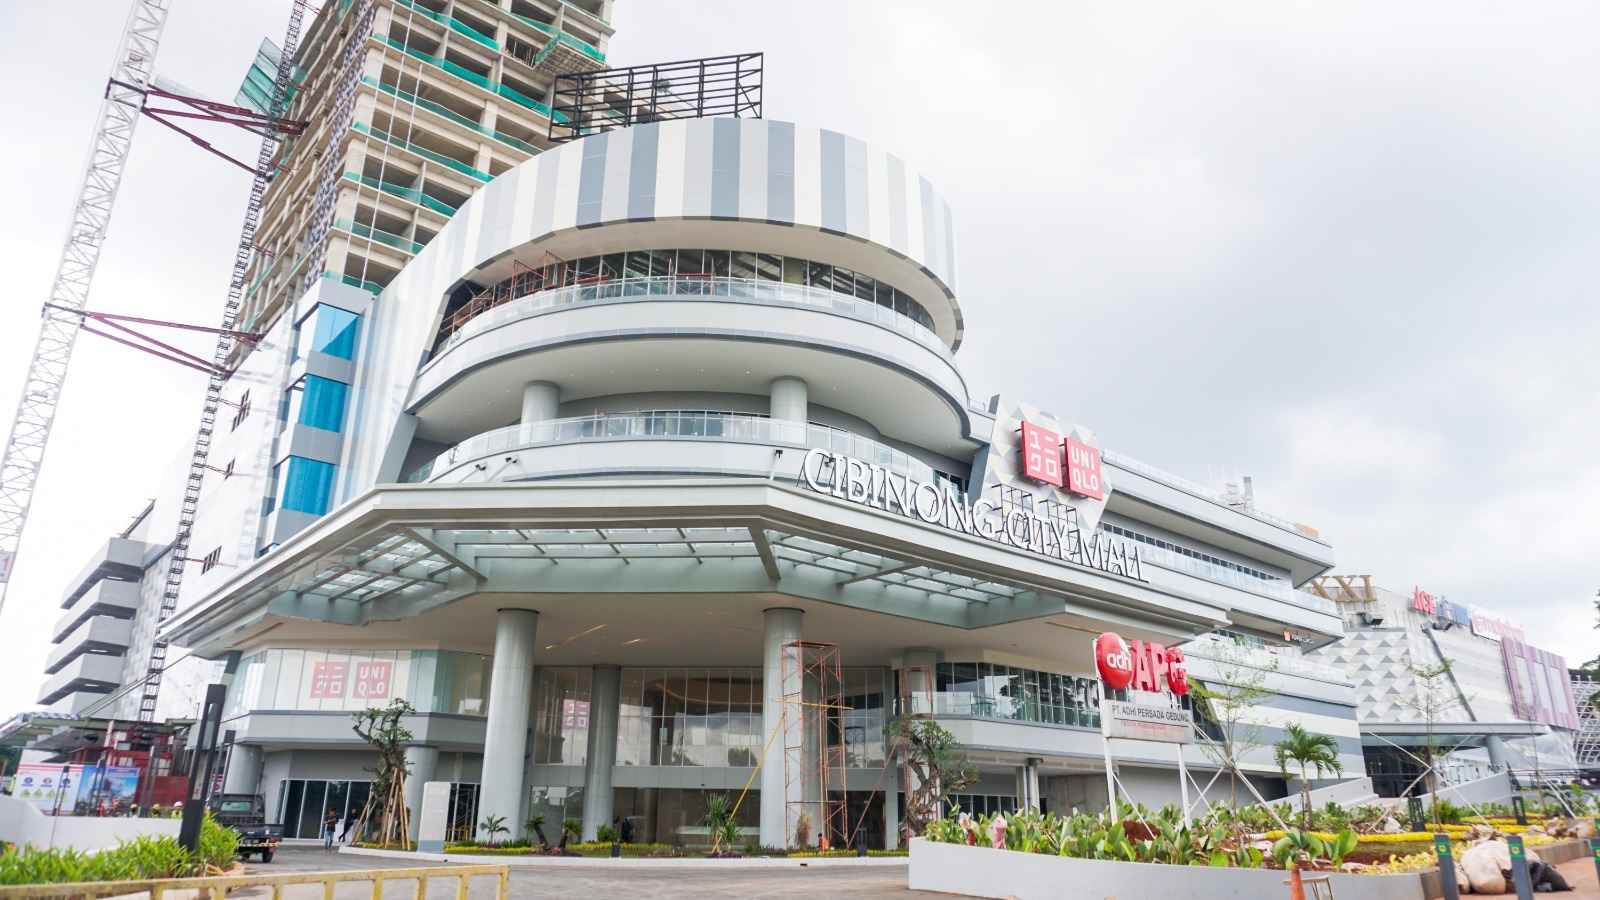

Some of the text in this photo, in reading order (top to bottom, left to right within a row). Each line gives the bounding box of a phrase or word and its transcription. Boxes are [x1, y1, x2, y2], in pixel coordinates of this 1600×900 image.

[1071, 446, 1096, 471] UNI
[1072, 467, 1098, 491] QLO
[803, 448, 1150, 584] CIBINONG CITY MALL
[1106, 651, 1132, 671] adhi
[360, 665, 385, 680] UNI
[1137, 707, 1165, 721] PERSADA
